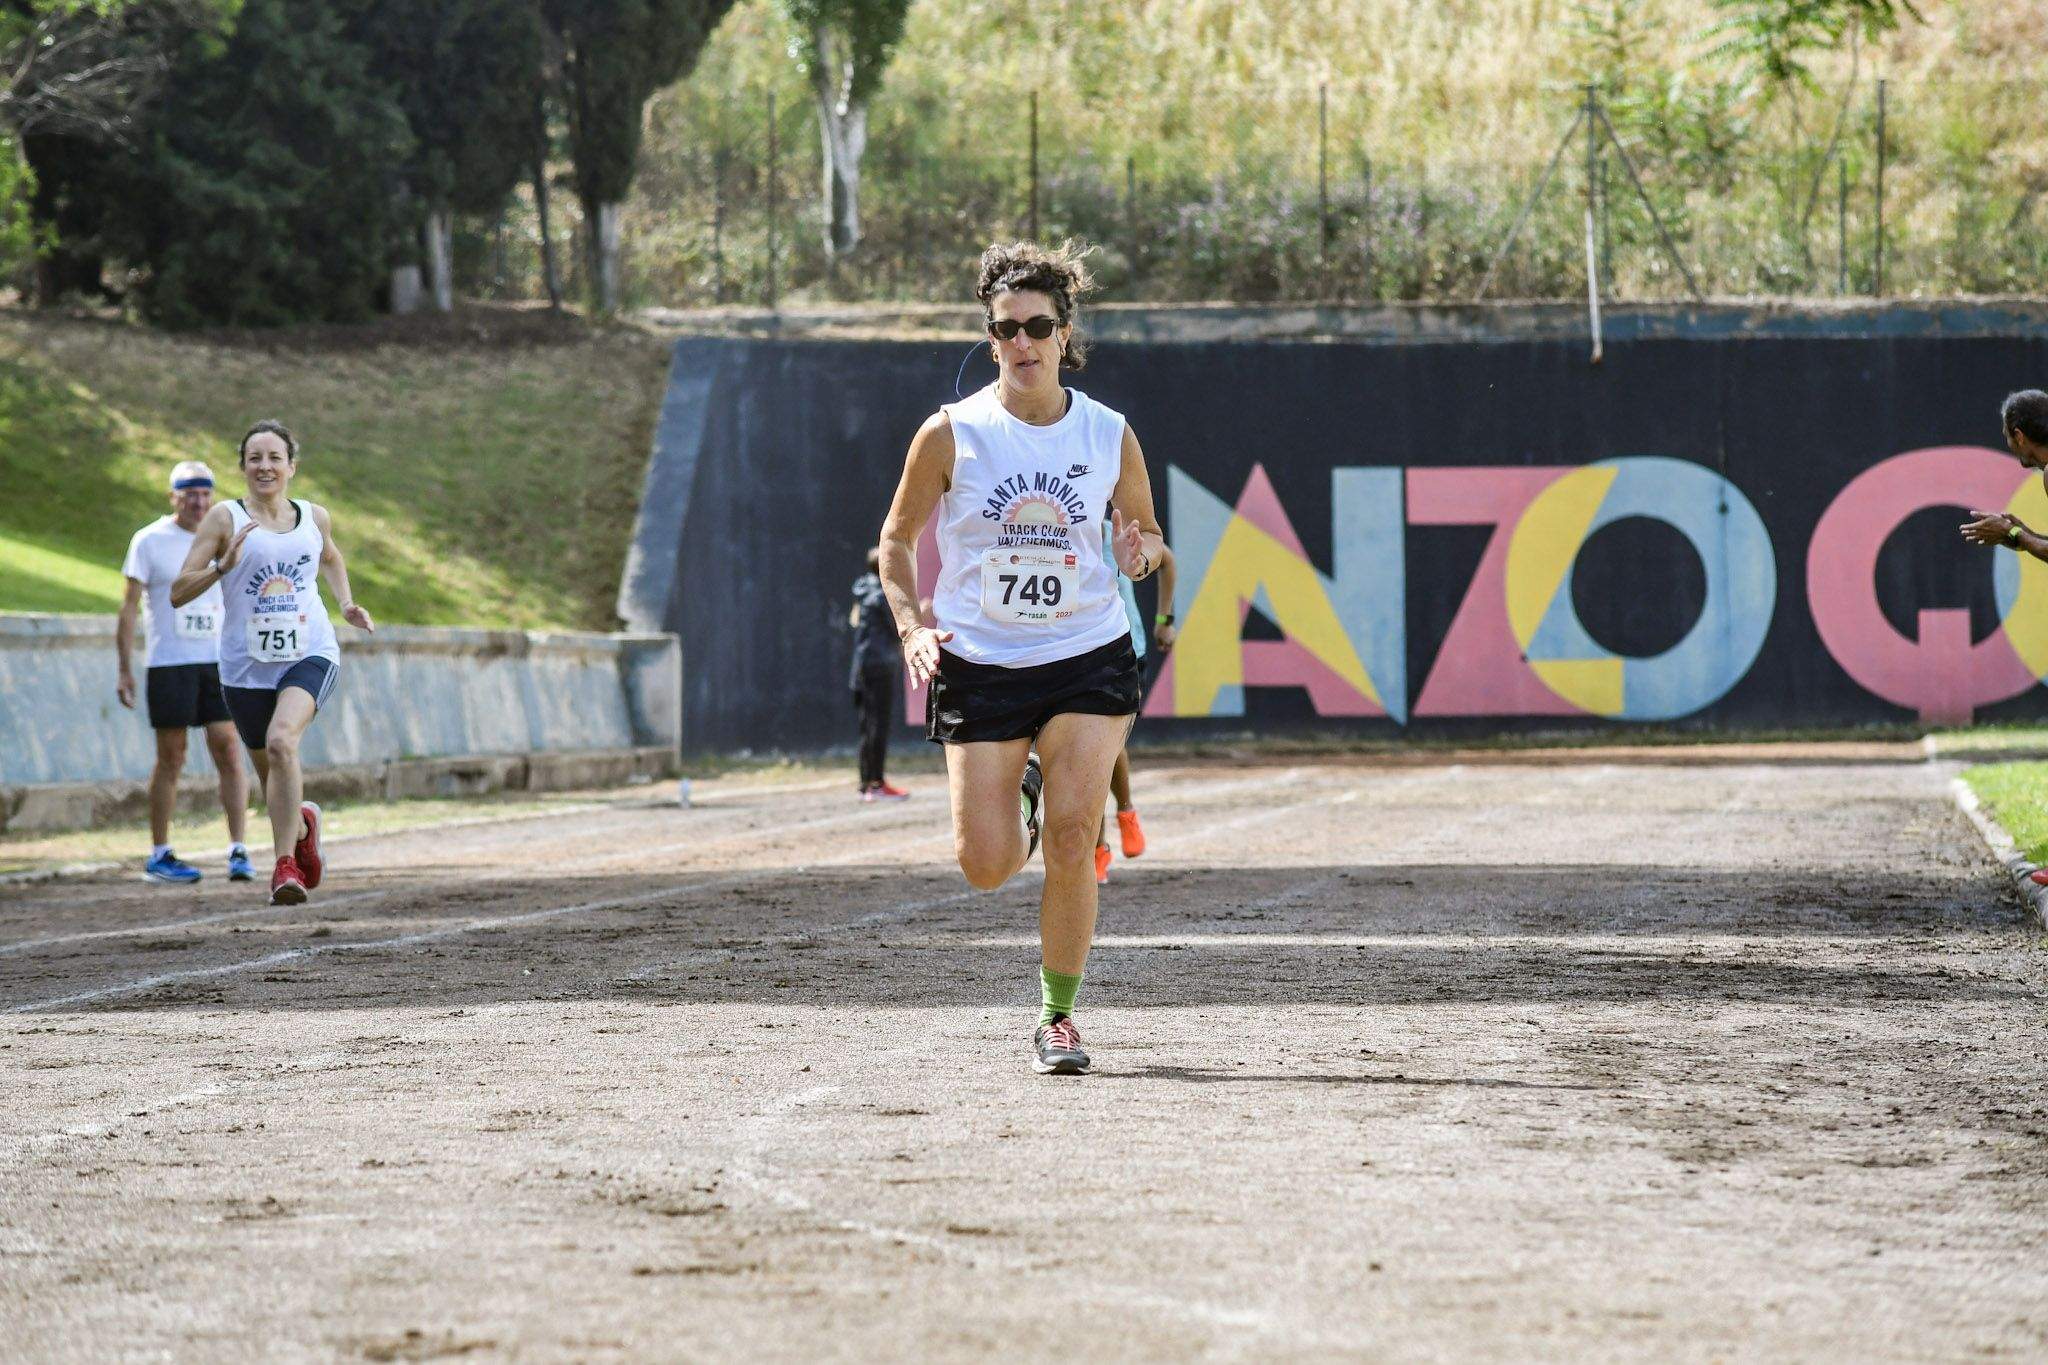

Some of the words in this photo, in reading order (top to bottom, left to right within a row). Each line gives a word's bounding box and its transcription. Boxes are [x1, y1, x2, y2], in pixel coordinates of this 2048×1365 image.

[1071, 464, 1089, 473] NIKE
[983, 473, 1029, 521] SANTA
[1034, 471, 1088, 525] MONICA
[1002, 524, 1038, 536] TRACK
[1042, 525, 1068, 538] CLUB
[245, 565, 274, 595] SANTA
[904, 455, 1778, 725] ANZO
[999, 574, 1062, 606] 749
[258, 629, 297, 651] 751
